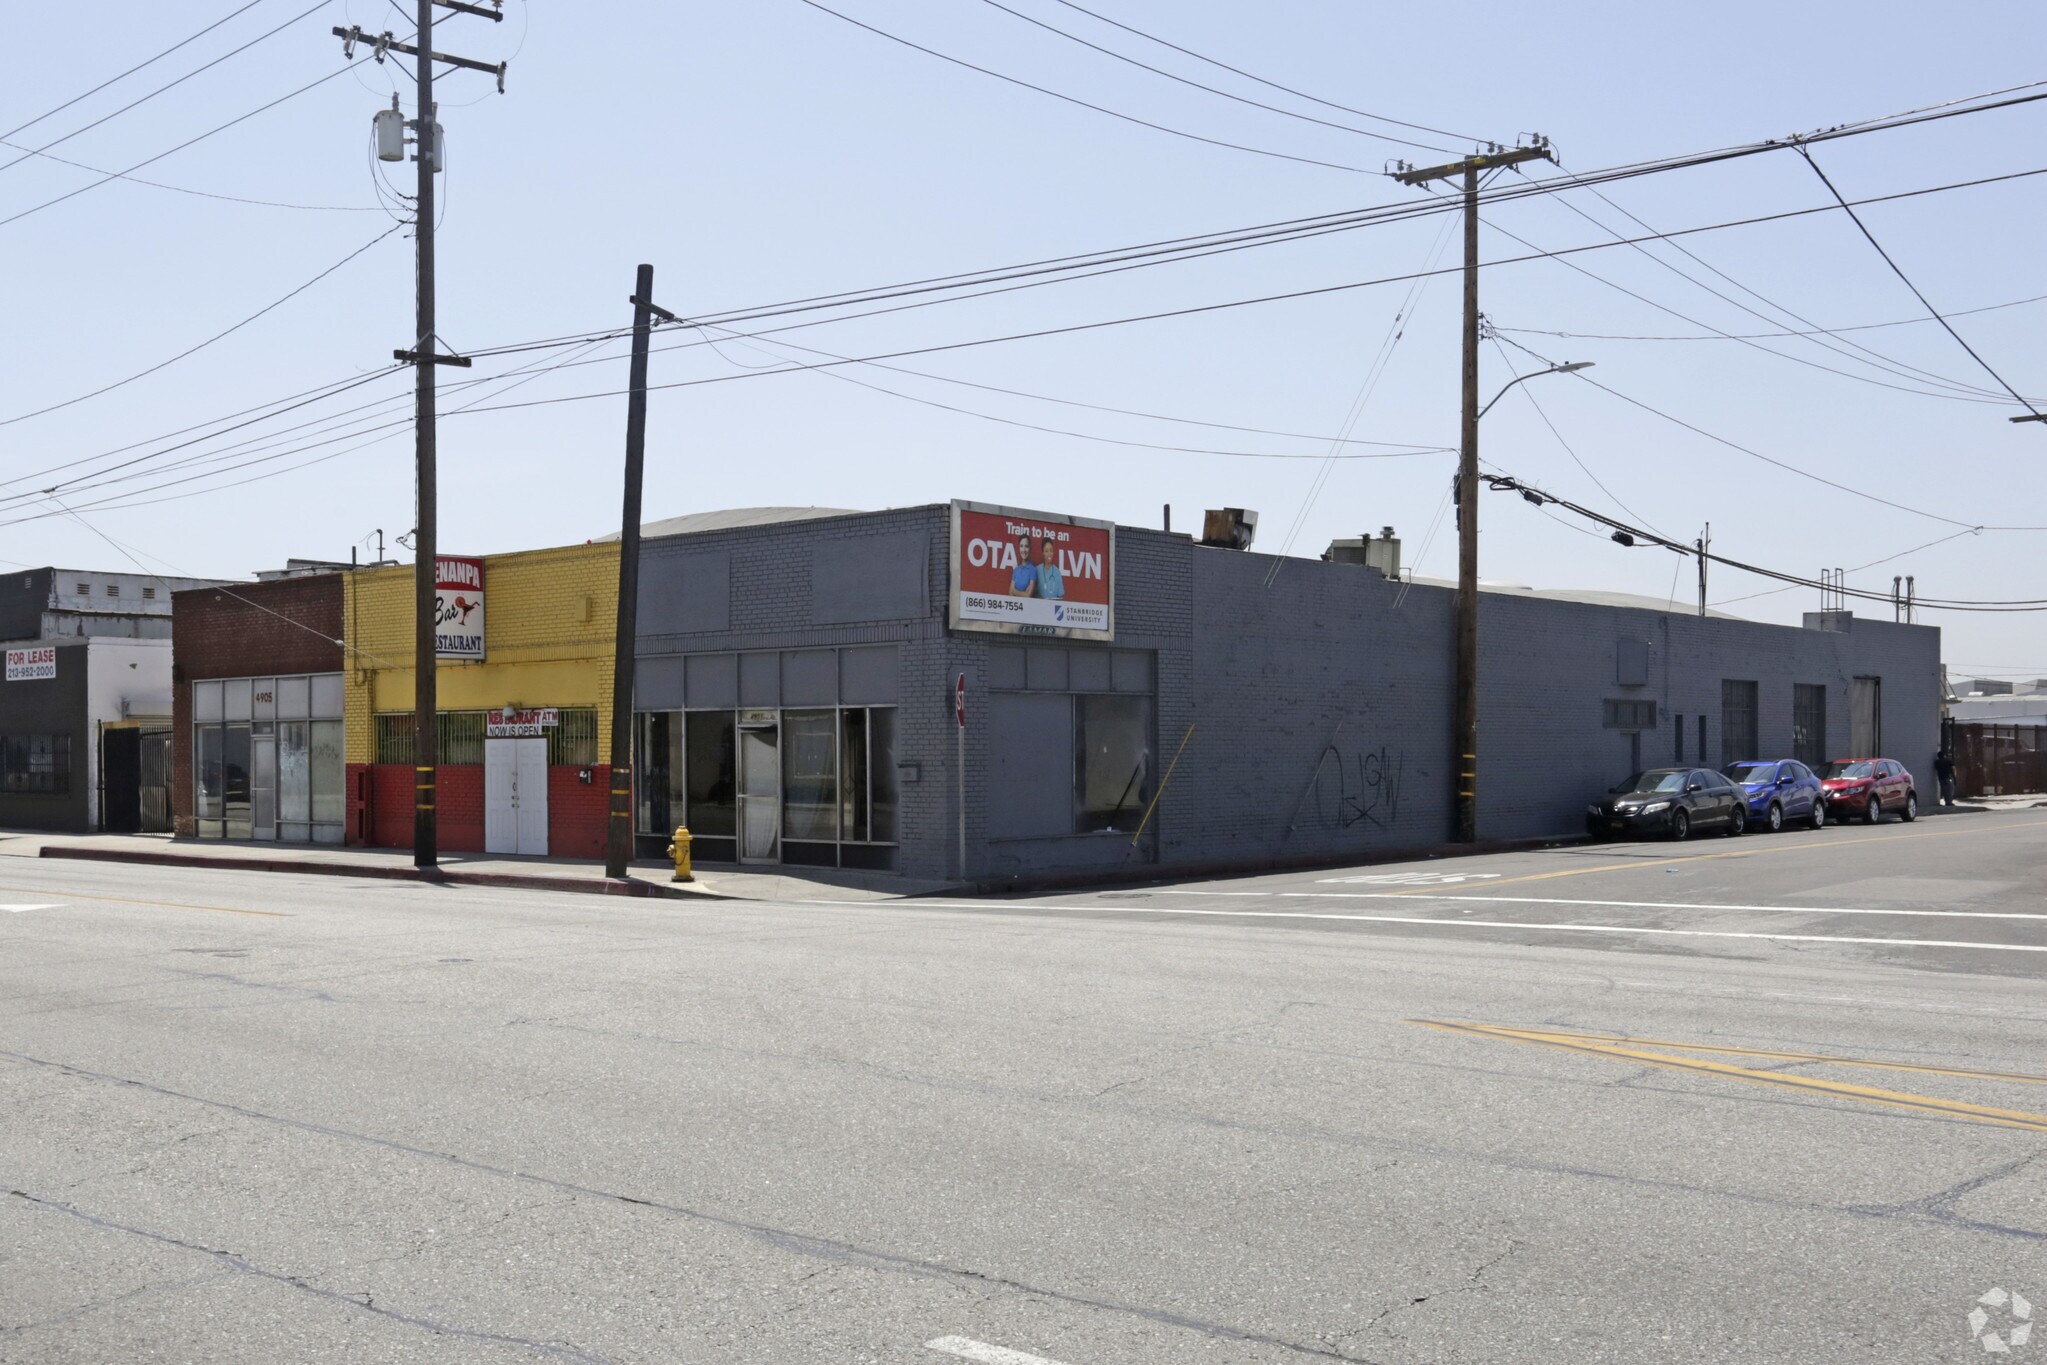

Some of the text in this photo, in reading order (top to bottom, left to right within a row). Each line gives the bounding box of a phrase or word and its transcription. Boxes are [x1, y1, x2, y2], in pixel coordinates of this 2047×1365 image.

[1006, 521, 1069, 542] Train to be an
[967, 537, 1018, 570] OTA
[1058, 549, 1101, 579] LVN
[965, 596, 1024, 611] (866) 984-7554
[435, 596, 459, 626] Bar
[1066, 607, 1103, 617] STANBRIDGE
[1066, 615, 1102, 624] UNIVERSITY
[436, 634, 482, 651] STAURANT
[8, 649, 54, 666] FOR LEASE
[8, 665, 54, 678] 213-952-2000
[255, 691, 273, 703] 4905
[489, 711, 541, 725] RESURANT
[542, 711, 558, 721] ATM
[489, 725, 539, 736] NOW IS OPEN
